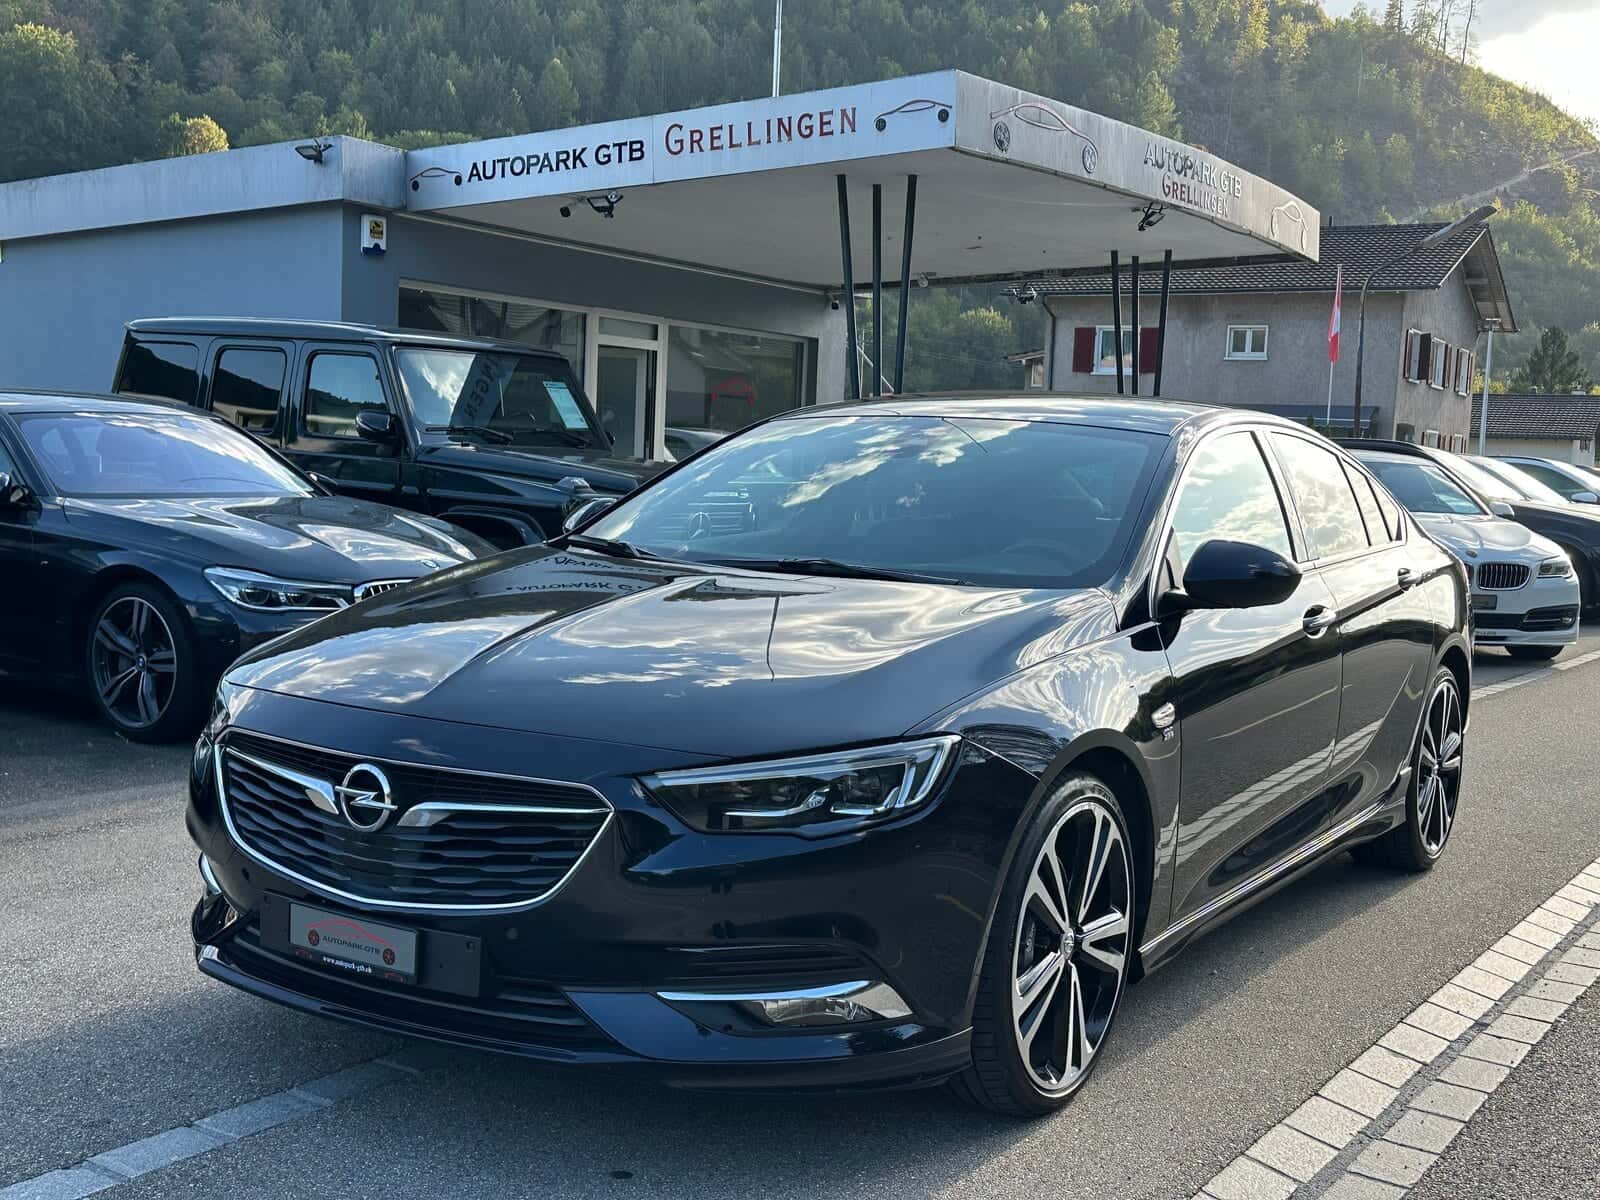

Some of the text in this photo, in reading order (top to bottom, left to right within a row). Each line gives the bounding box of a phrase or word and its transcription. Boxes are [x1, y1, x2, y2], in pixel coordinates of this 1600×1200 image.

[664, 106, 857, 156] GRELLINGEN
[467, 139, 646, 183] AUTOPARK GTB
[1143, 142, 1242, 199] AUTOPARK GTB
